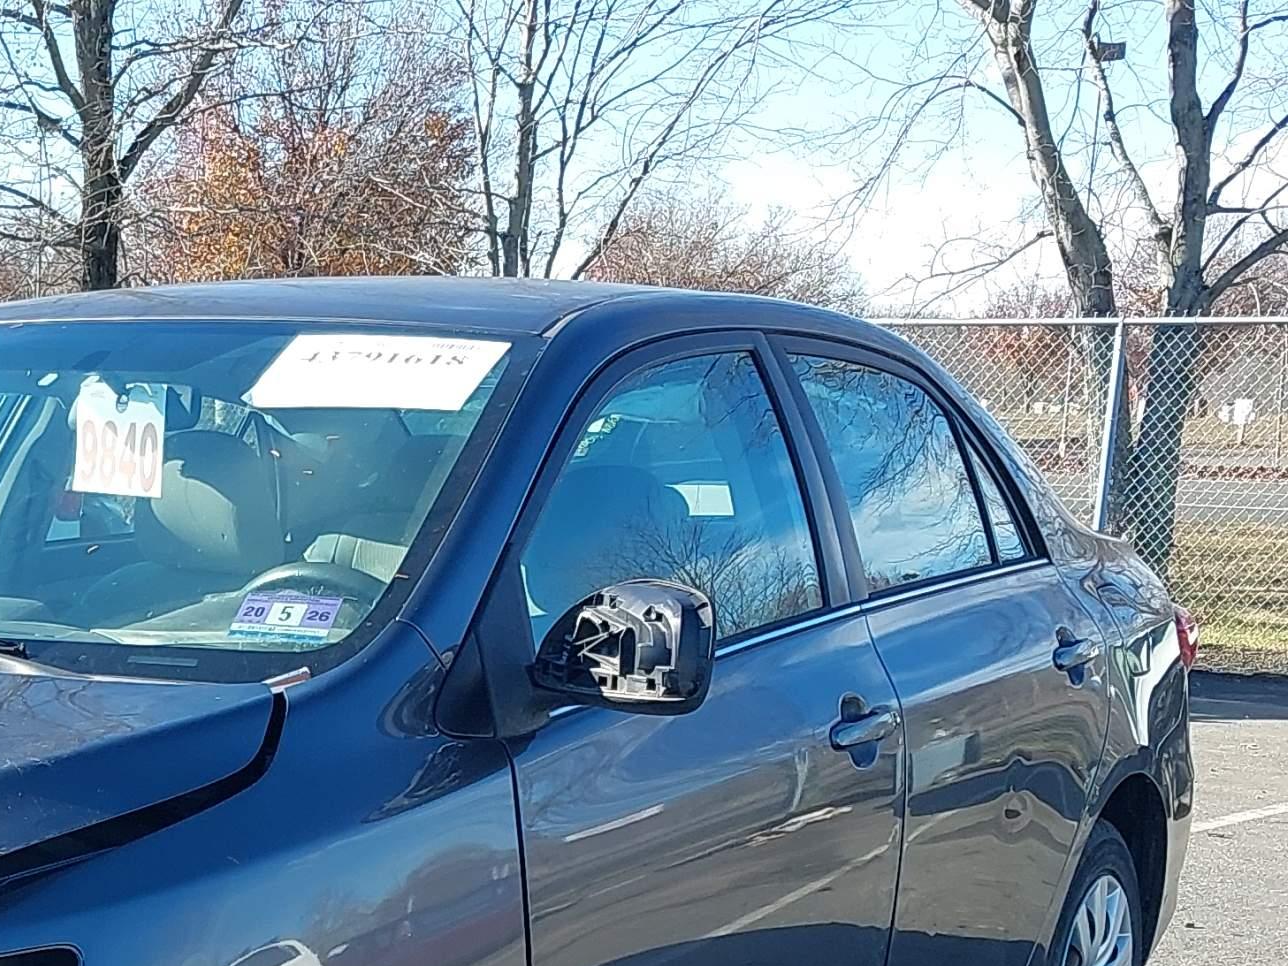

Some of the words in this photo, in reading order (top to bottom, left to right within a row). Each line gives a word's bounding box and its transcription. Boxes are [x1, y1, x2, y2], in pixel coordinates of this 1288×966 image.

[80, 419, 158, 493] 9840
[242, 606, 266, 618] 20
[278, 605, 295, 622] 5
[306, 610, 332, 622] 26
